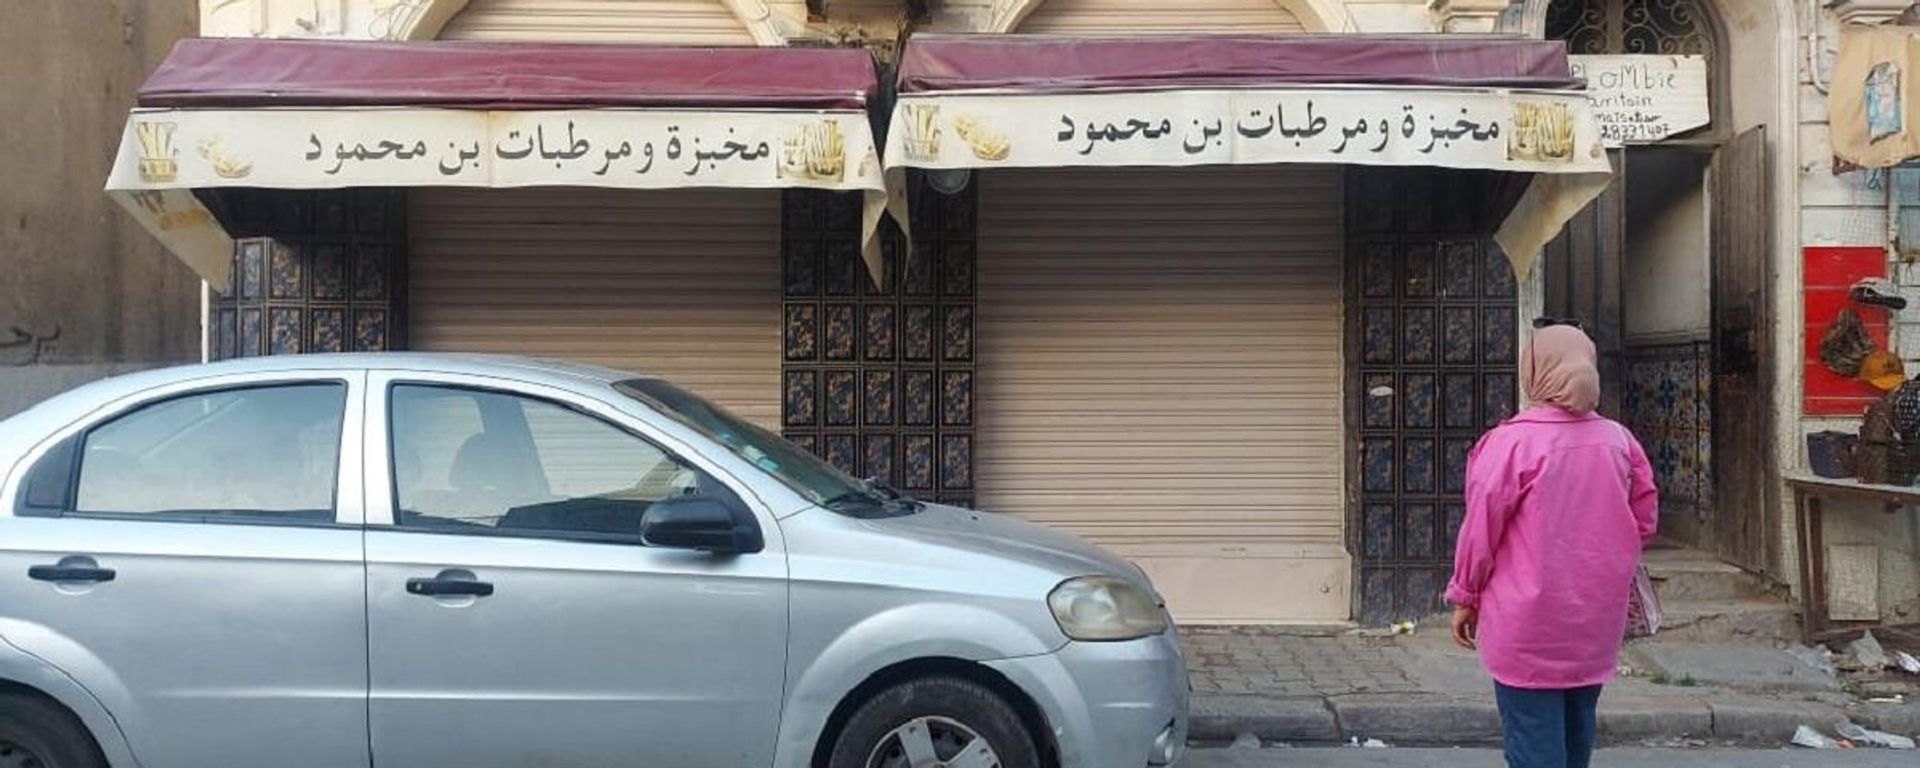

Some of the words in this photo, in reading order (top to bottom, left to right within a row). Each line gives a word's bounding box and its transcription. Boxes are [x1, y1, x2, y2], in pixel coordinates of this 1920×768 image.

[666, 126, 770, 177] مخبزة
[1057, 111, 1173, 155] محمود
[1181, 112, 1224, 156] بن
[1400, 105, 1499, 155] مخبزة
[304, 132, 427, 175] محمود
[438, 138, 482, 177] بن
